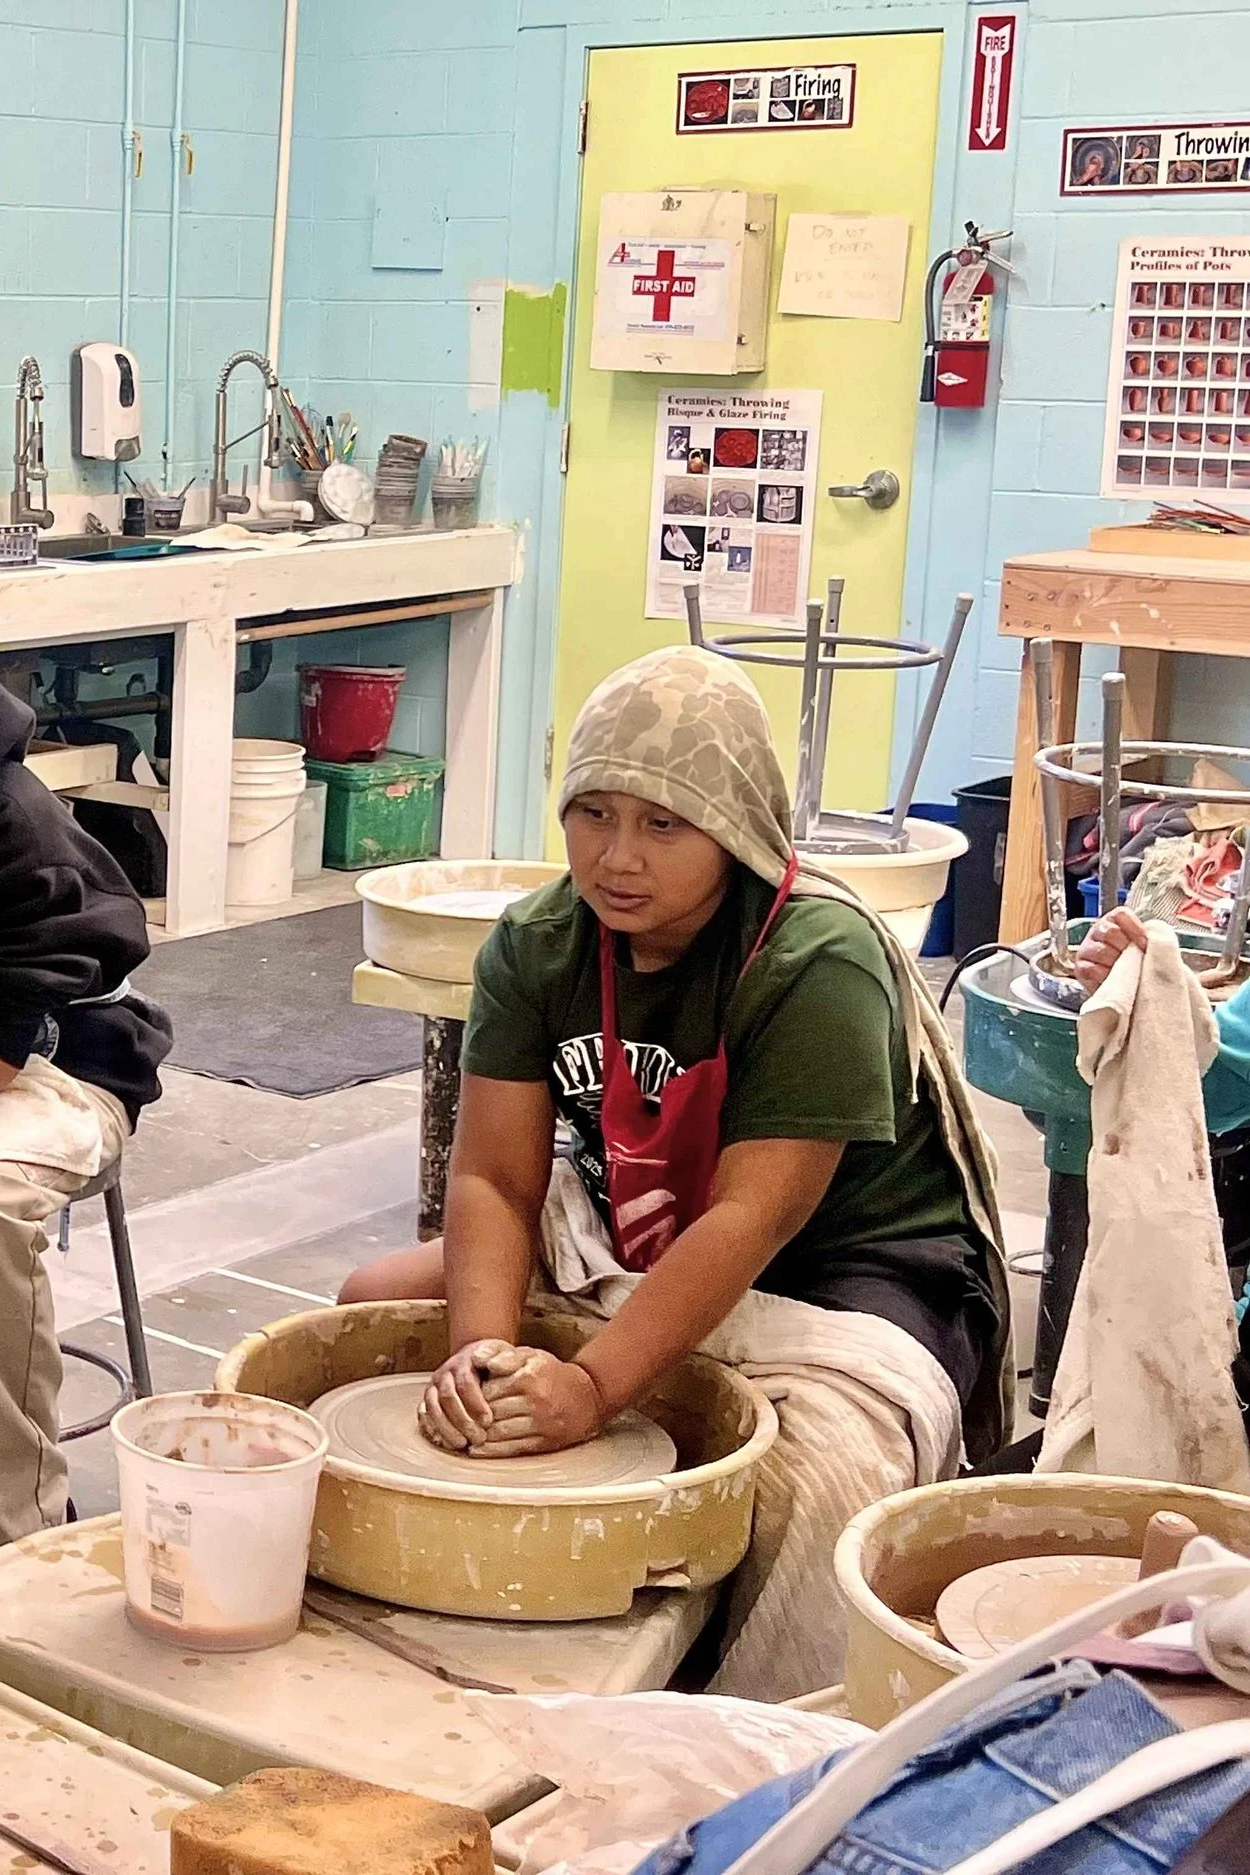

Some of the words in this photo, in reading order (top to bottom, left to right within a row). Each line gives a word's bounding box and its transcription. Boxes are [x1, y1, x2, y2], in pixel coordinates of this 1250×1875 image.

[984, 35, 1007, 52] FIRE
[794, 73, 842, 101] Firing
[1174, 131, 1250, 156] Throwin
[1130, 246, 1206, 259] Ceramics:
[1130, 260, 1183, 272] Profiles
[1185, 260, 1200, 271] of
[1203, 260, 1232, 272] Pots
[632, 279, 670, 293] FIRST
[671, 281, 695, 294] AID
[667, 394, 727, 407] Ceramics:
[730, 396, 790, 410] Throwing
[667, 407, 704, 419] Bisque
[706, 408, 716, 418] &
[718, 408, 749, 418] Glaze
[752, 409, 786, 421] Firing
